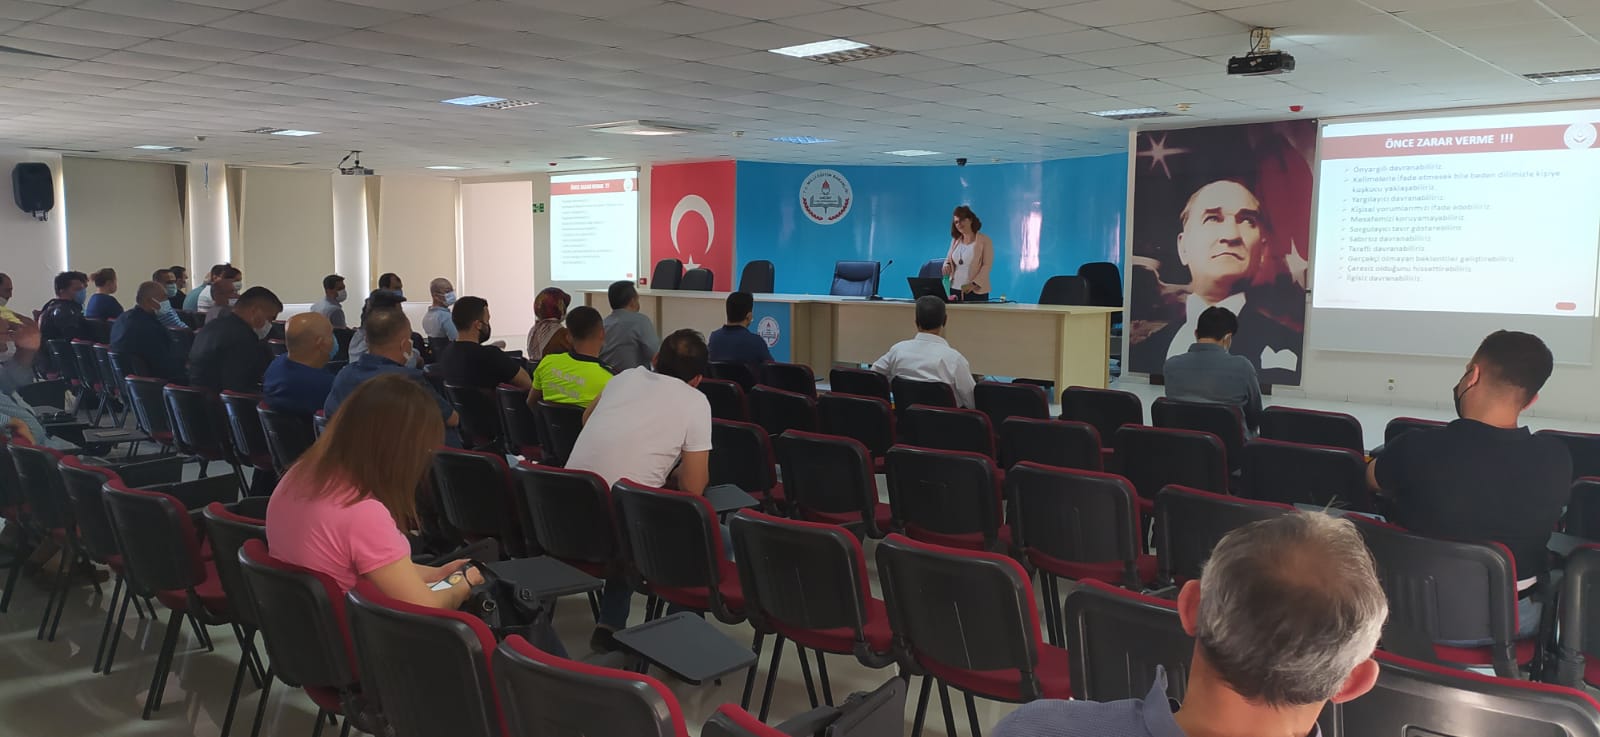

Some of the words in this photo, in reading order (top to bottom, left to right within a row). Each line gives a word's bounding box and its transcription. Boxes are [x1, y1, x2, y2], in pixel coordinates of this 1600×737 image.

[1385, 137, 1414, 149] ÖNCE
[1416, 136, 1453, 147] ZARAR
[1455, 134, 1494, 146] VERME
[1500, 133, 1514, 144] !!!
